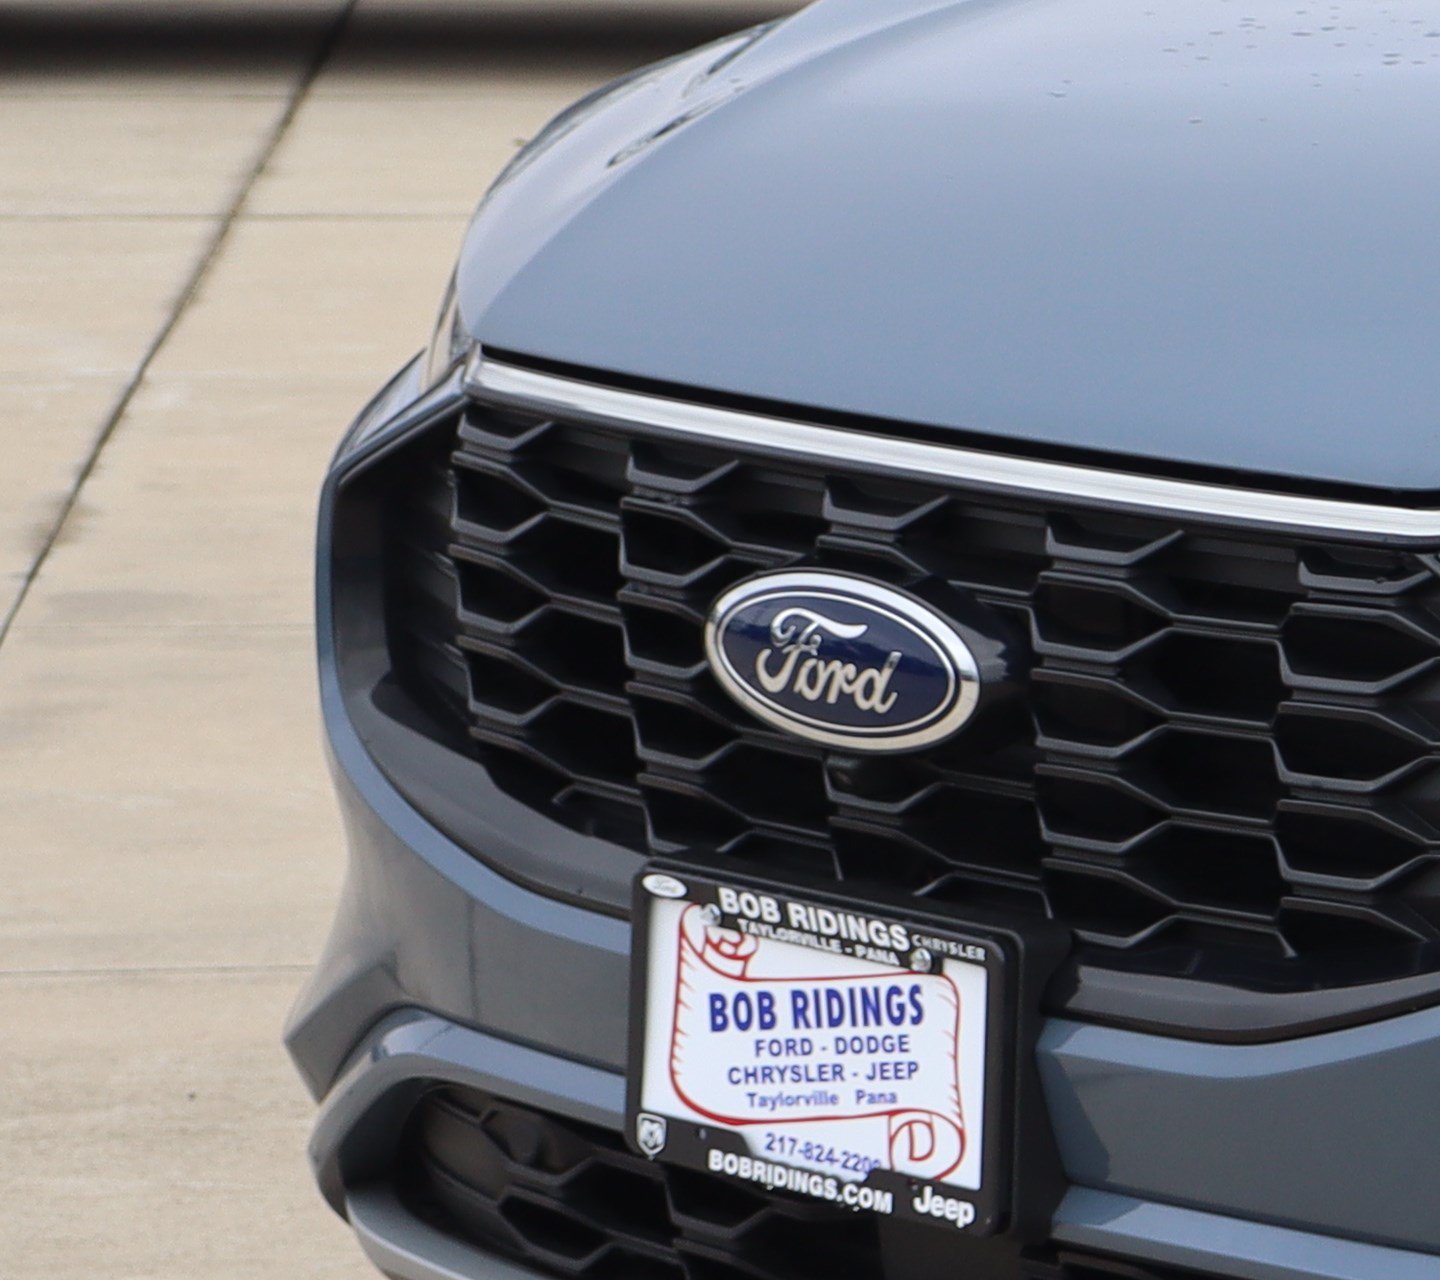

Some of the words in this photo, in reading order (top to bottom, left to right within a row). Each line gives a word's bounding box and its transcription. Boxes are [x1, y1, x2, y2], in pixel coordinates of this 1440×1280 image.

[756, 606, 903, 714] Ford
[718, 887, 781, 923] BOB
[787, 902, 910, 952] RIDINGS
[737, 918, 842, 955] TAYLORVILLE
[855, 945, 900, 966] PANA
[911, 934, 986, 962] CHRYSLER
[708, 990, 777, 1032] BOB
[790, 984, 924, 1030] RIDINGS
[755, 1037, 813, 1057] FORD
[834, 1034, 911, 1055] DODGE
[727, 1064, 845, 1085] CHRYSLER
[866, 1061, 919, 1081] JEEP
[746, 1090, 840, 1111] Taylorville
[855, 1089, 898, 1106] Pana
[708, 1148, 893, 1215] BOBRIDINGS.COM
[913, 1185, 976, 1229] Jeep
